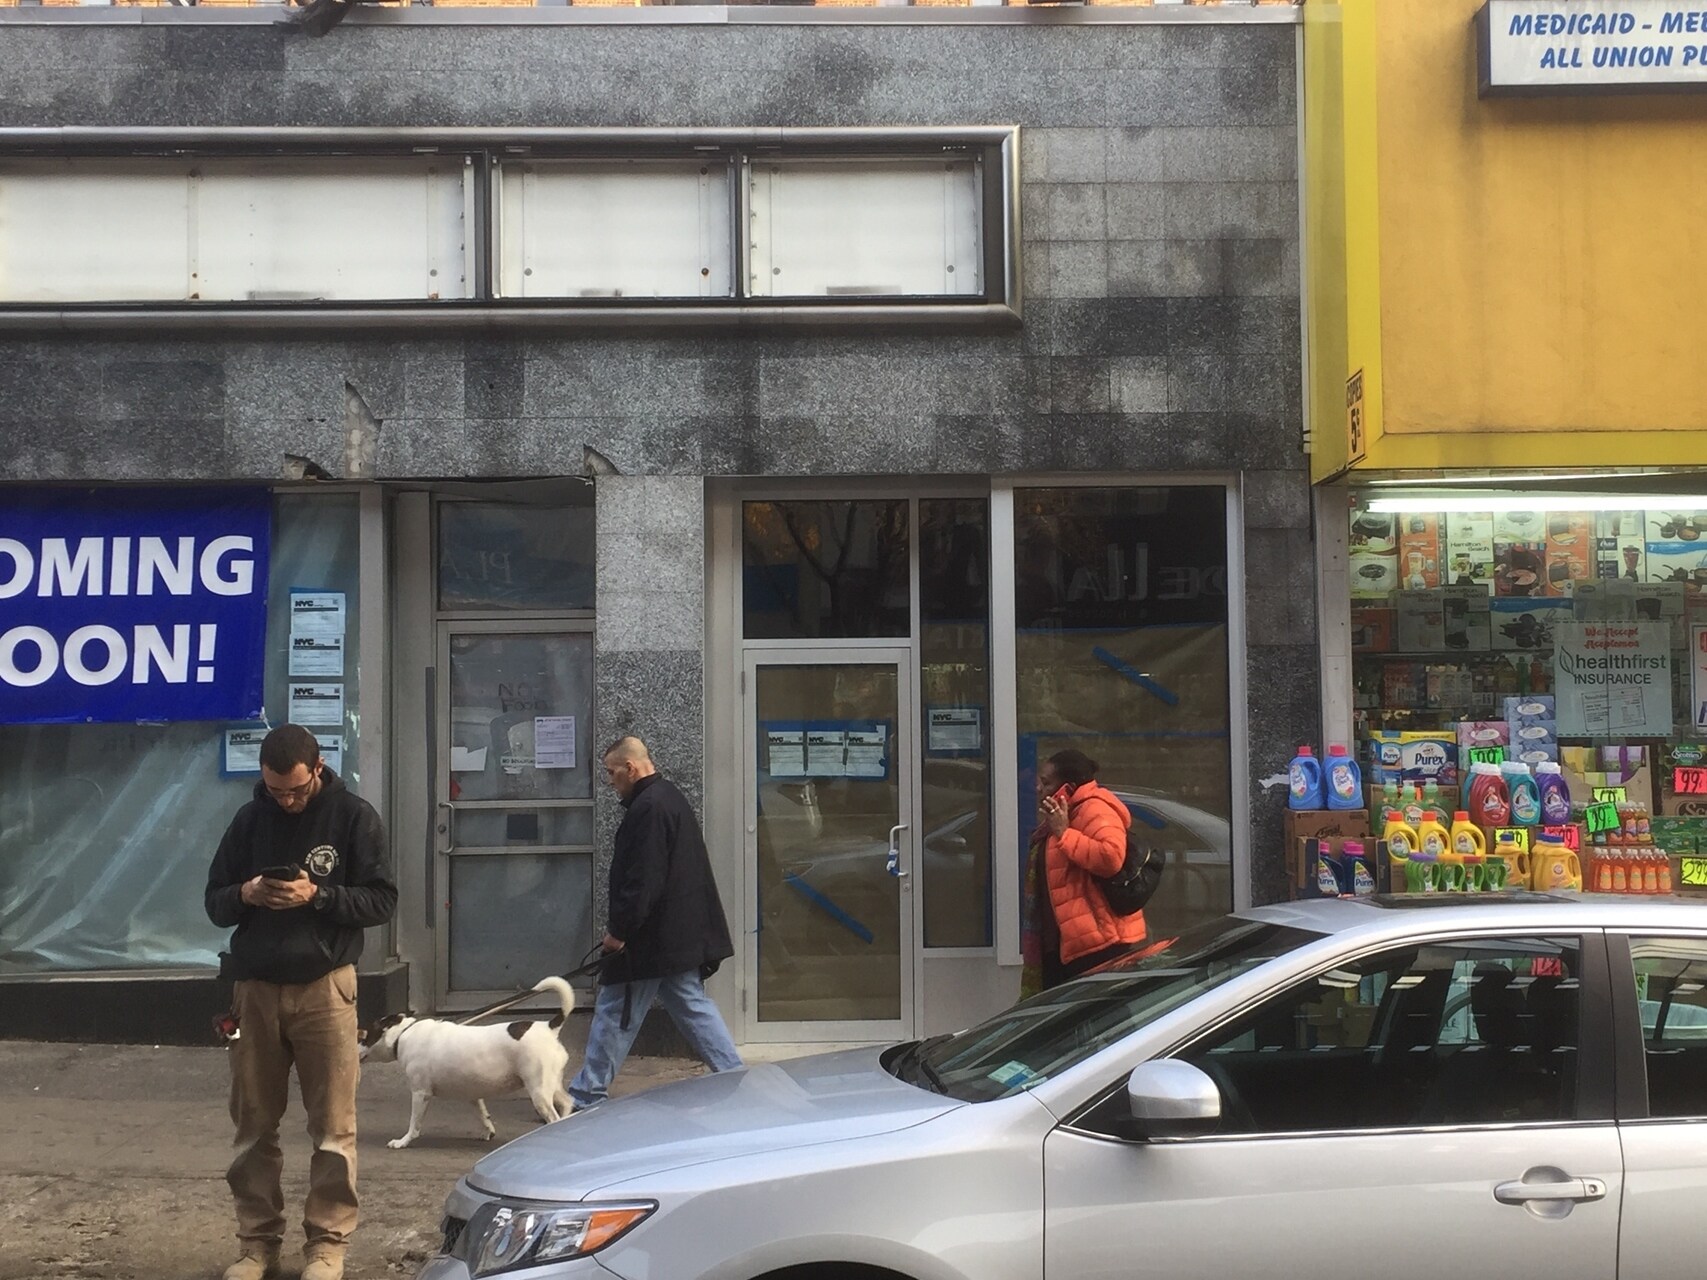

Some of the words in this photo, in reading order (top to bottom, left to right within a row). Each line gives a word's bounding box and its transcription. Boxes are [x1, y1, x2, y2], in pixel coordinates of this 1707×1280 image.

[1509, 13, 1635, 35] MEDICAID
[1540, 48, 1583, 68] ALL
[1592, 46, 1673, 67] UNION
[1576, 654, 1666, 669] healthfirst
[1574, 673, 1651, 685] INSURANCE
[1415, 752, 1444, 766] Purex
[1356, 878, 1374, 887] Purex
